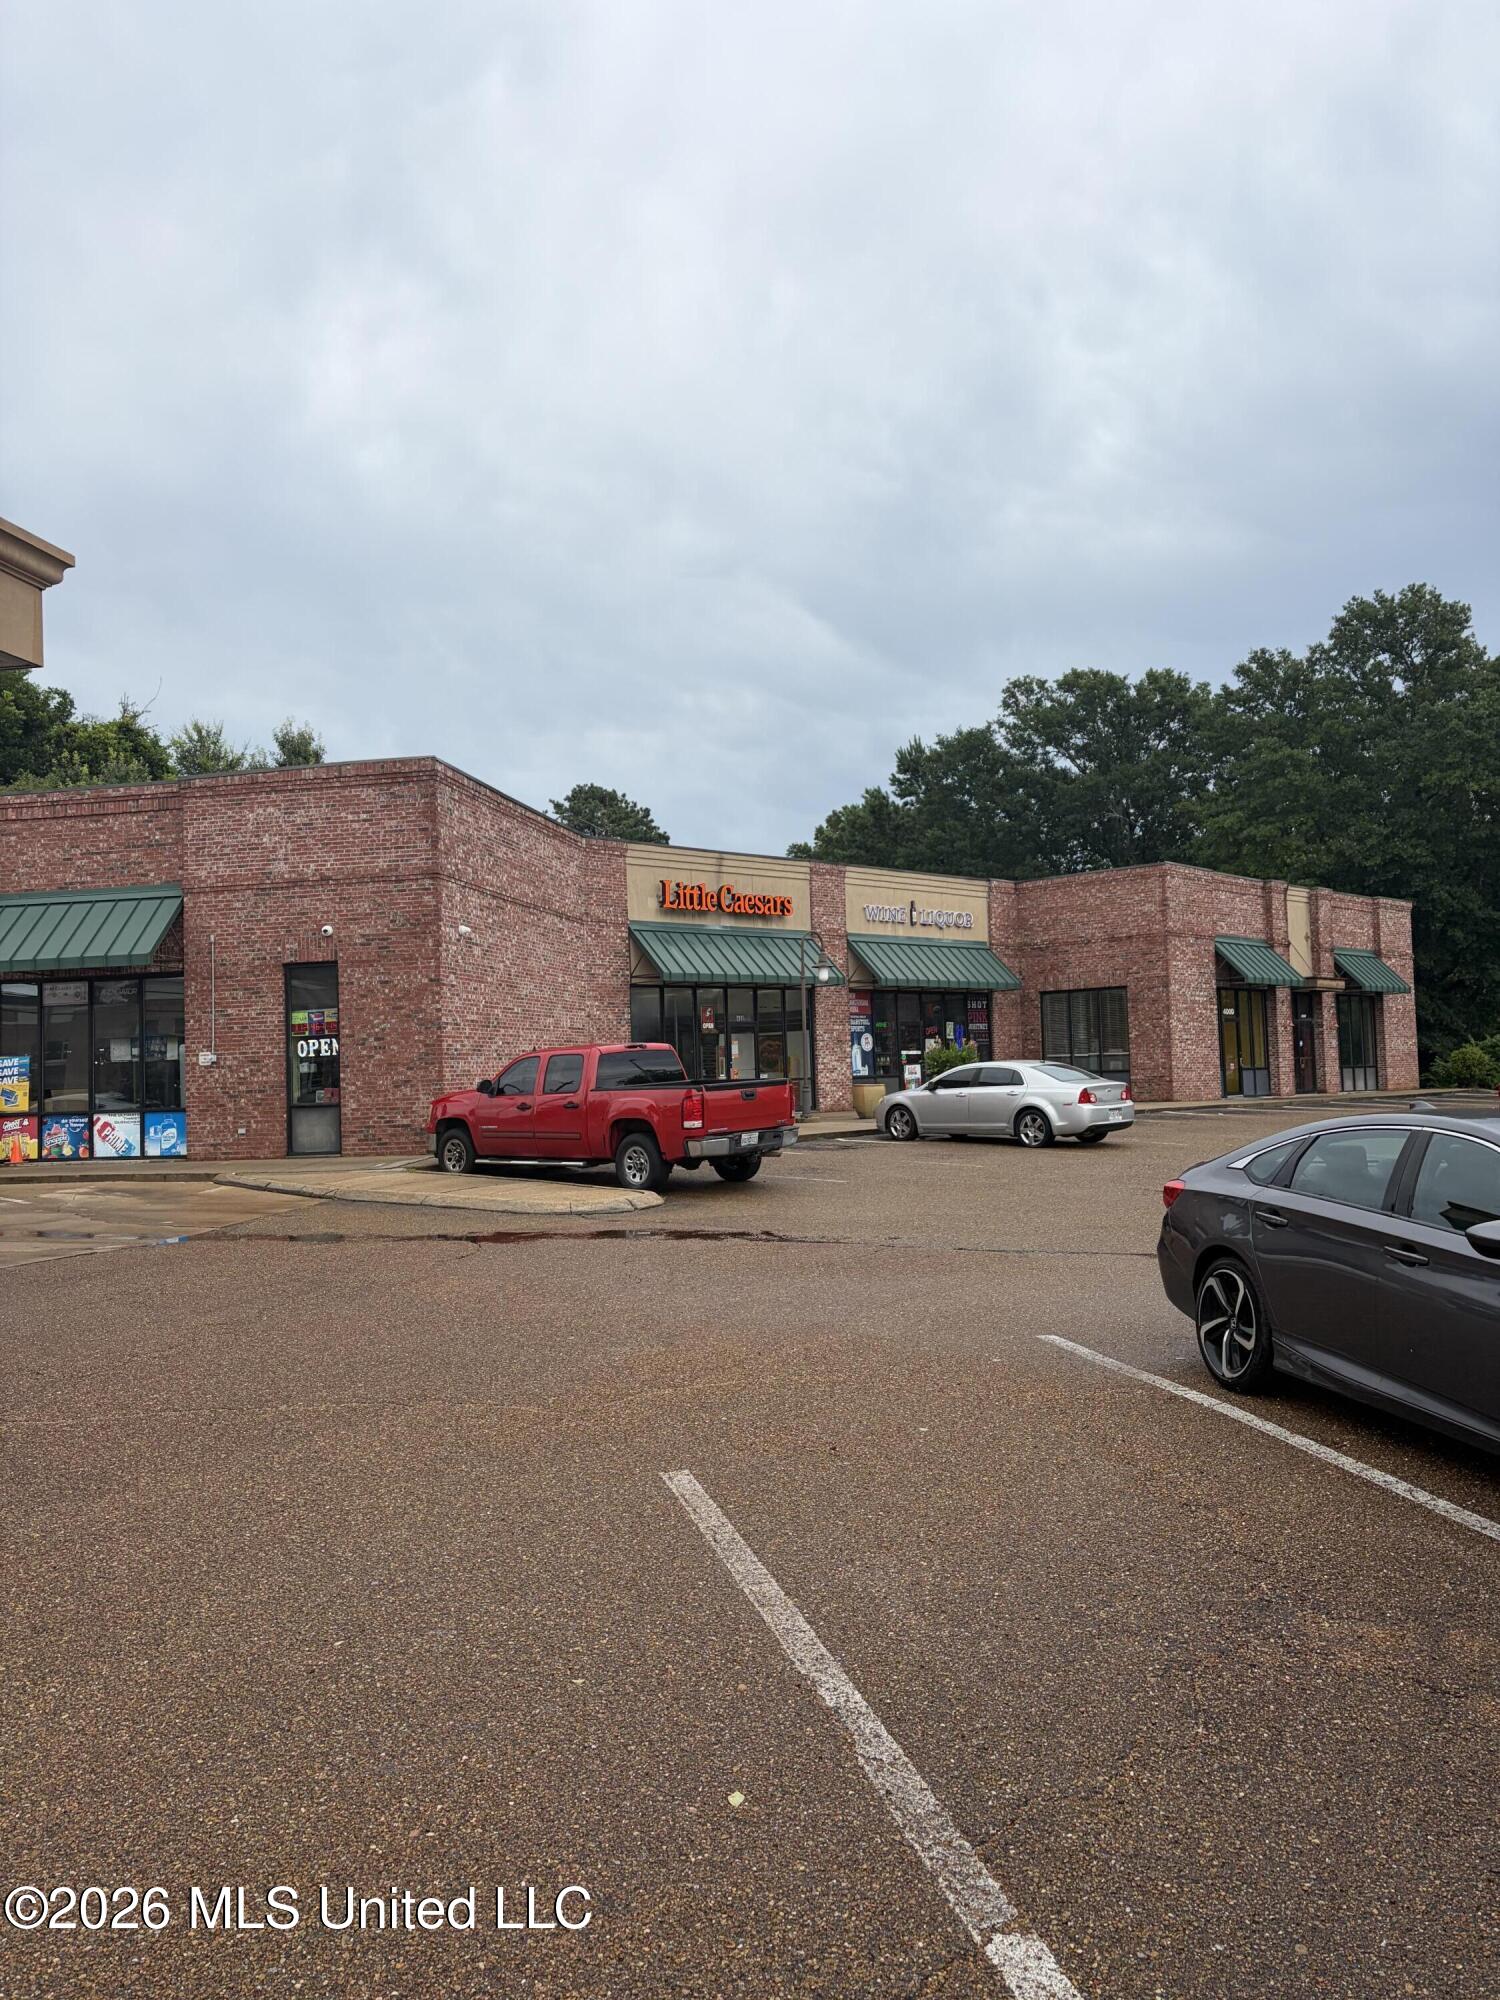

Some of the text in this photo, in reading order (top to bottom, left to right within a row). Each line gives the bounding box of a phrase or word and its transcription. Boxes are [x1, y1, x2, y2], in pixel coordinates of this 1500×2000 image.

[660, 879, 794, 917] Little Caesars
[863, 904, 974, 929] WINE LIQUOR
[101, 1127, 129, 1154] PRIME
